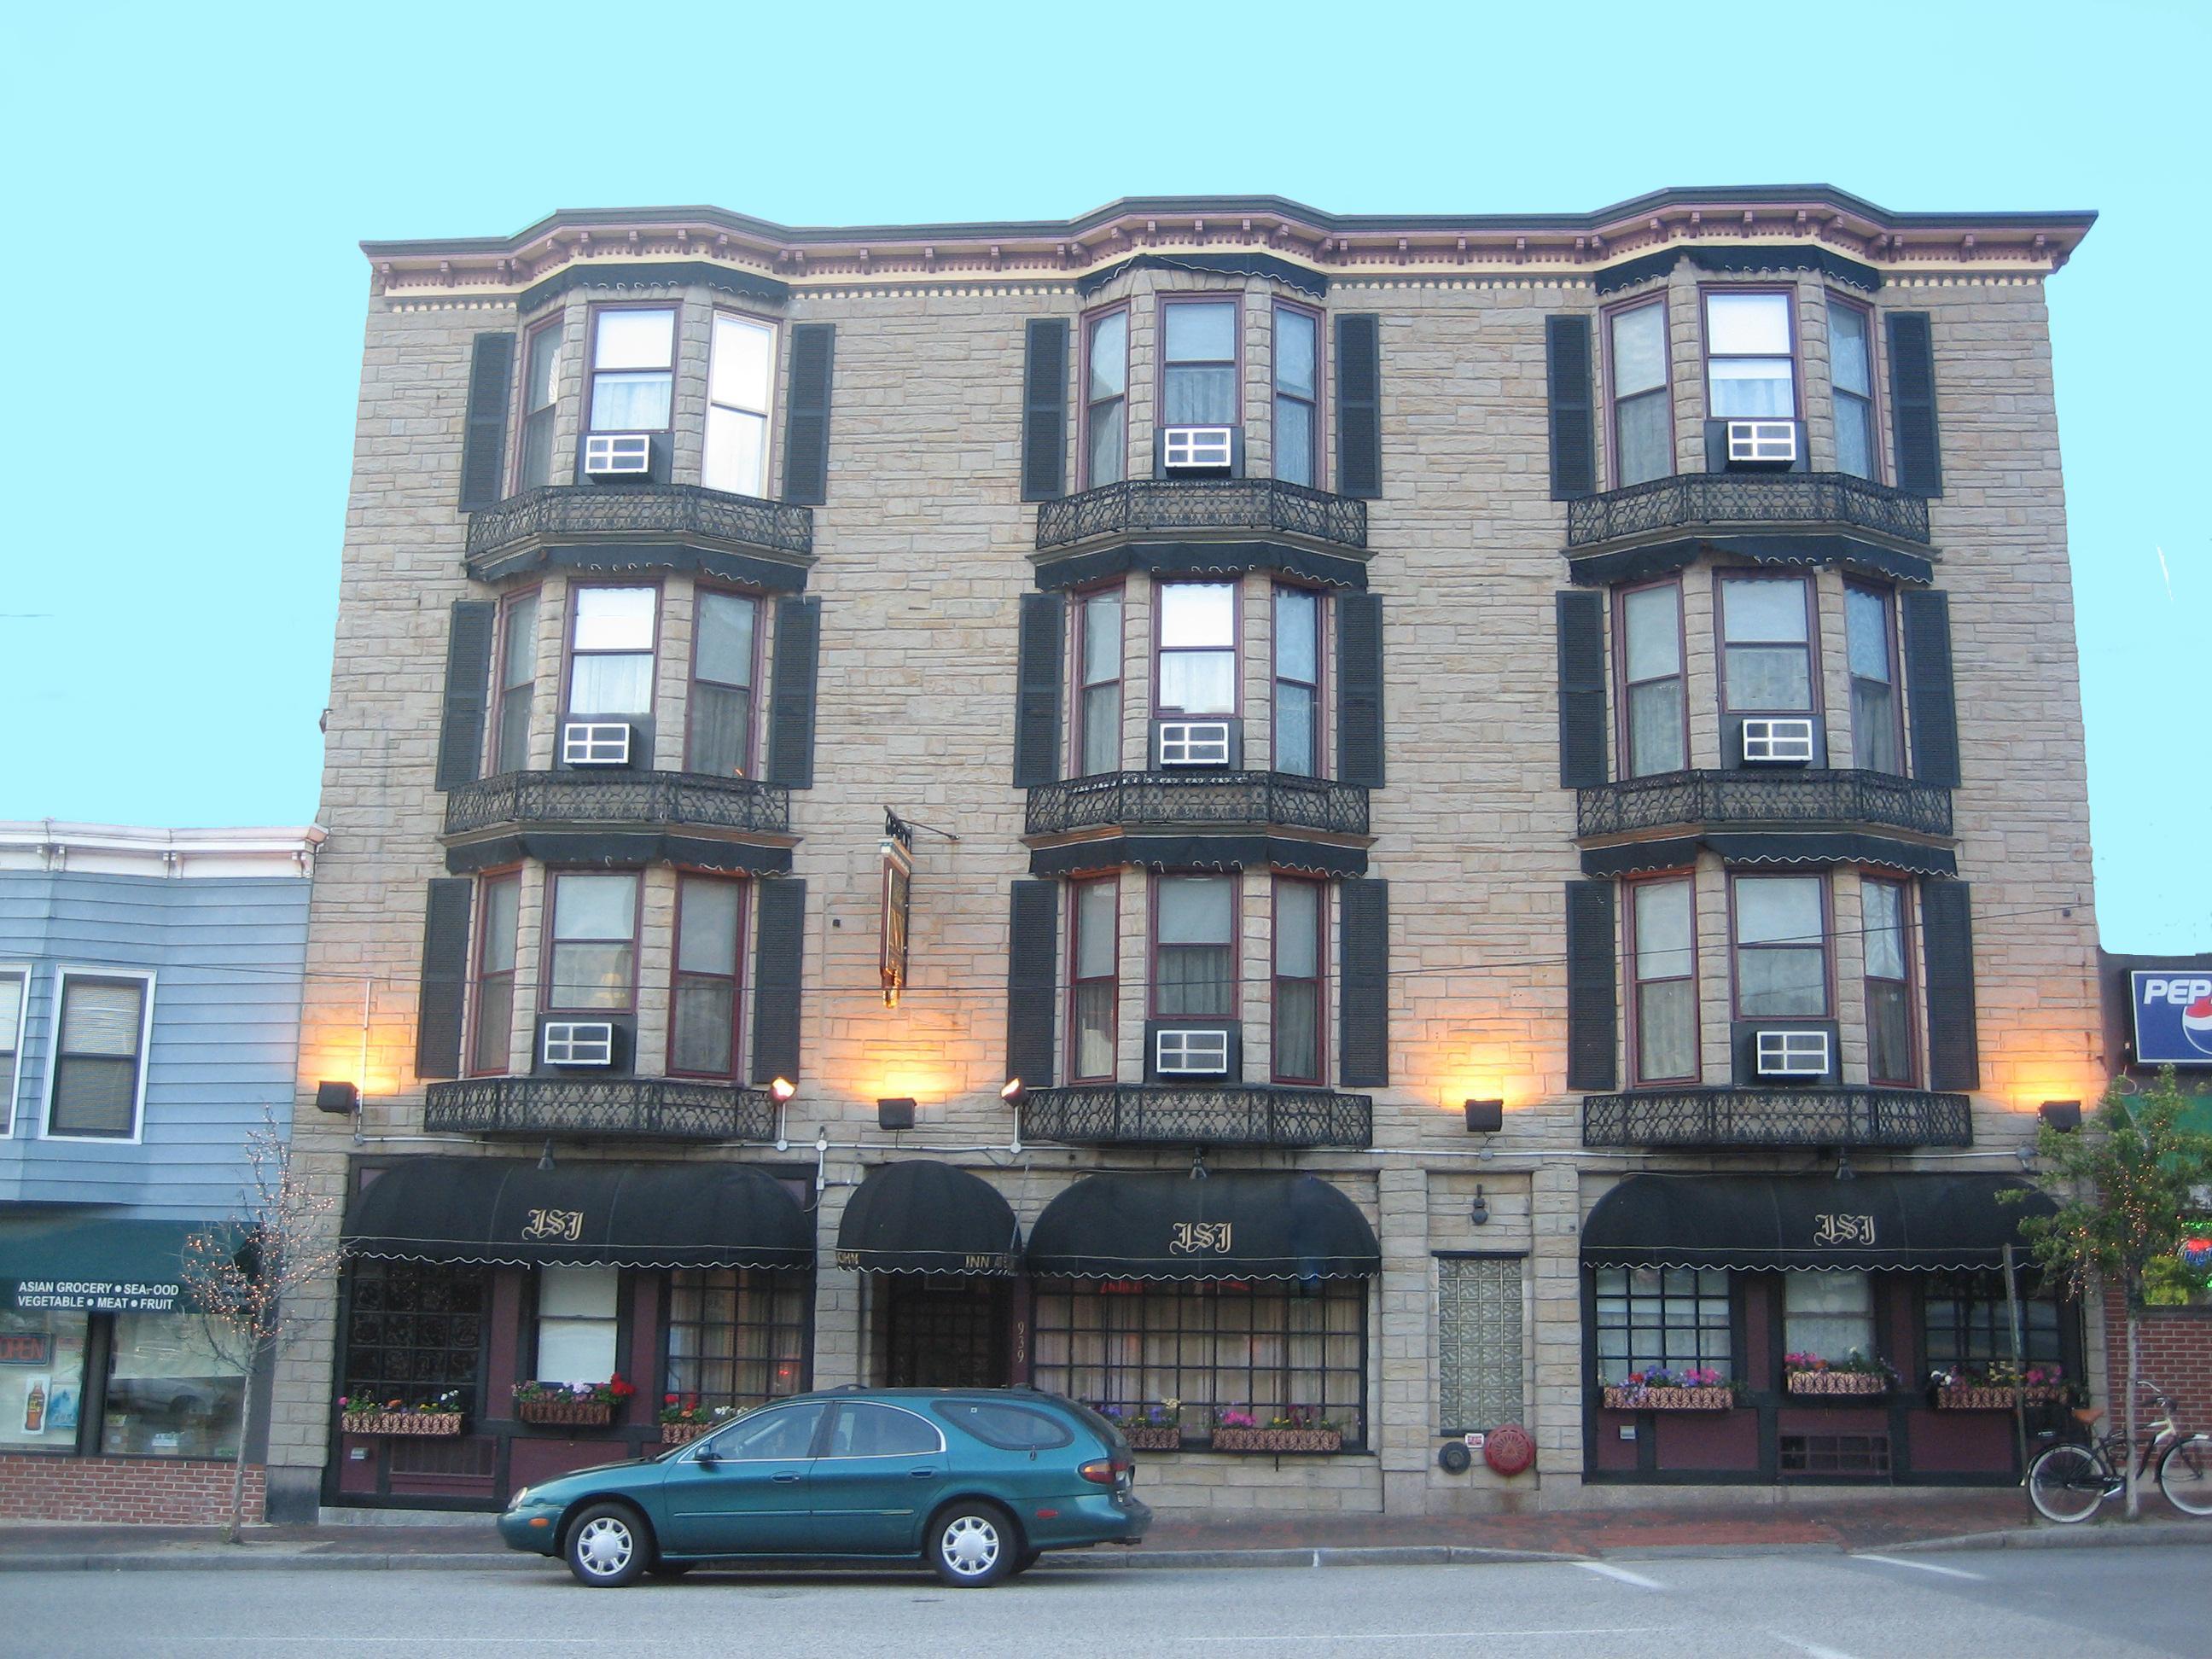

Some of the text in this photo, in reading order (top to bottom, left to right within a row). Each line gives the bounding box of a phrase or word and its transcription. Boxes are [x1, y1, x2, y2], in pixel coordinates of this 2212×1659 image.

[2143, 979, 2212, 1004] PEP
[965, 1255, 990, 1268] INN
[18, 1281, 54, 1293] ASIAN
[56, 1282, 114, 1294] GROCERY
[17, 1295, 174, 1310] VEGETABLE MEAT FRUIT
